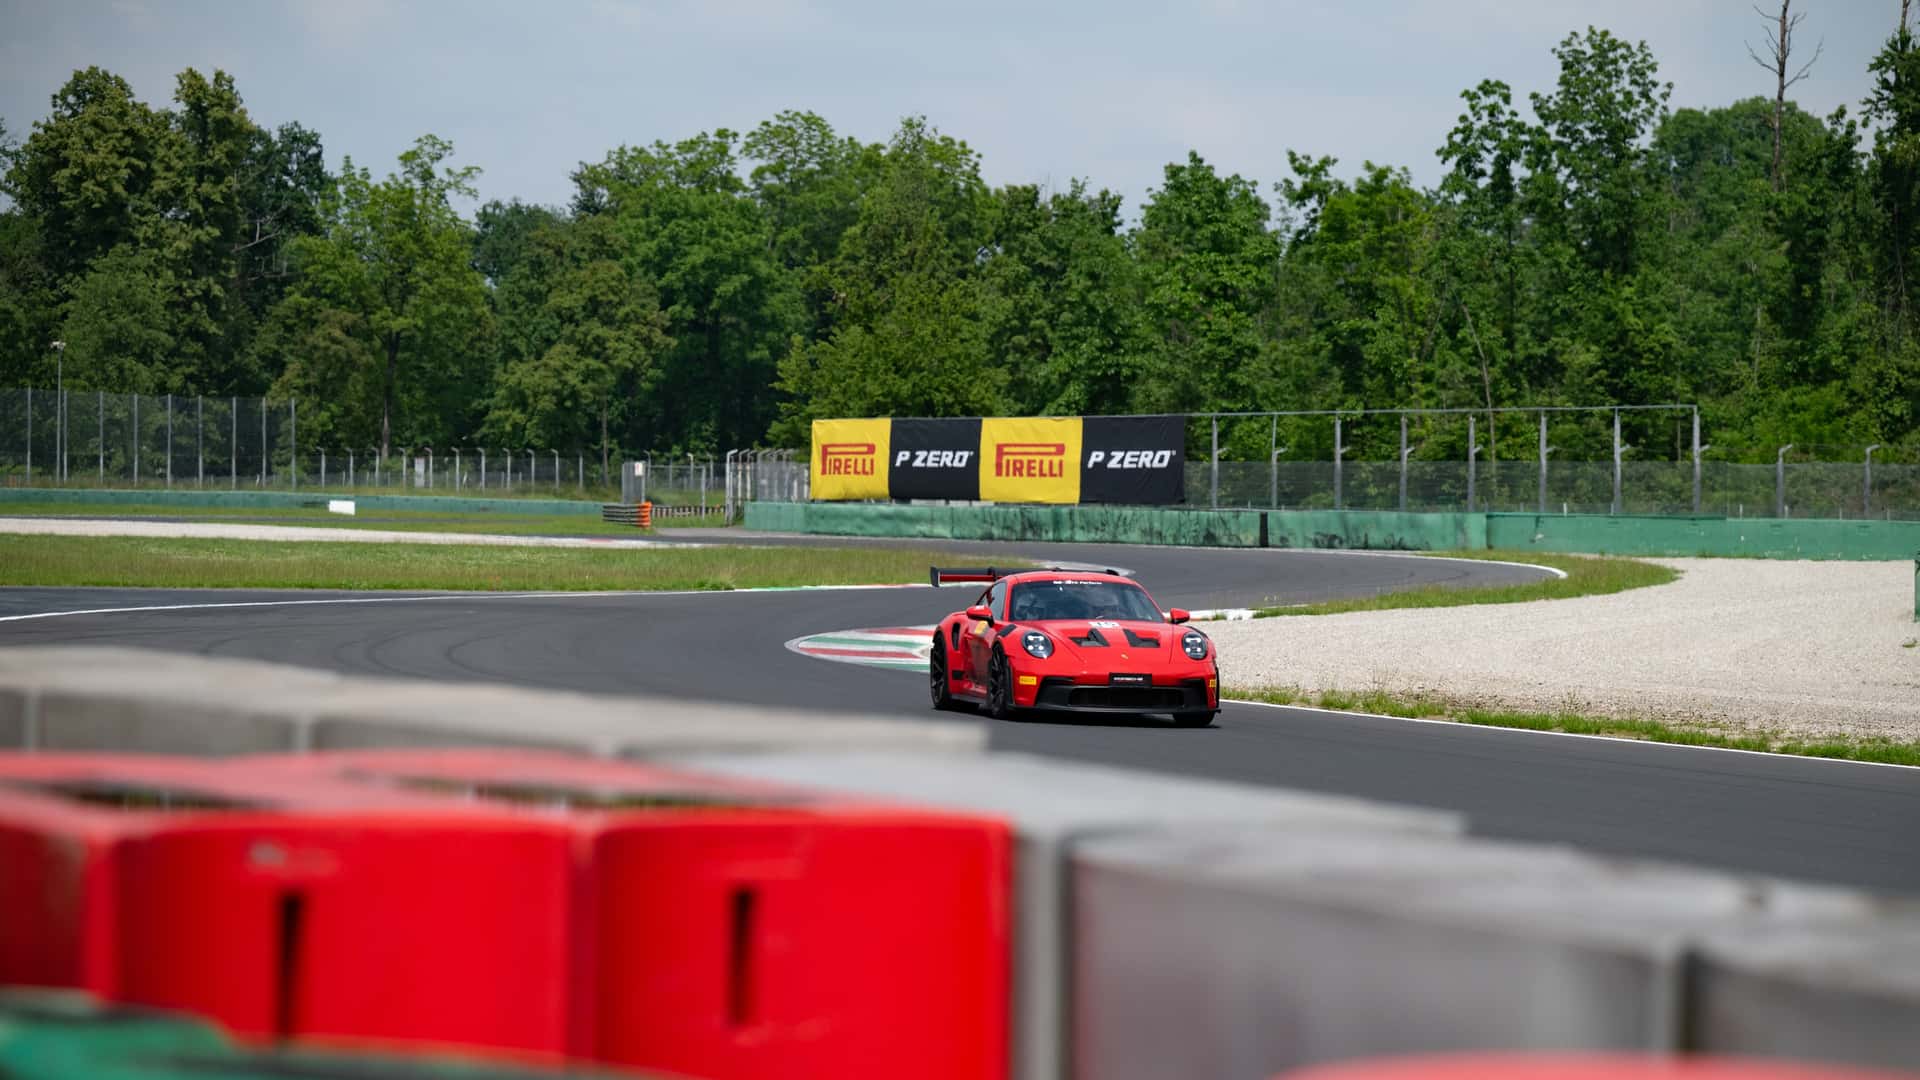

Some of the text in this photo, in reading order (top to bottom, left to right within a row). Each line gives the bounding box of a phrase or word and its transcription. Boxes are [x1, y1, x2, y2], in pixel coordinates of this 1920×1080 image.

[821, 443, 876, 475] PIRELLI
[895, 450, 911, 467] P
[995, 443, 1066, 478] PIRELLI
[1087, 450, 1105, 468] P
